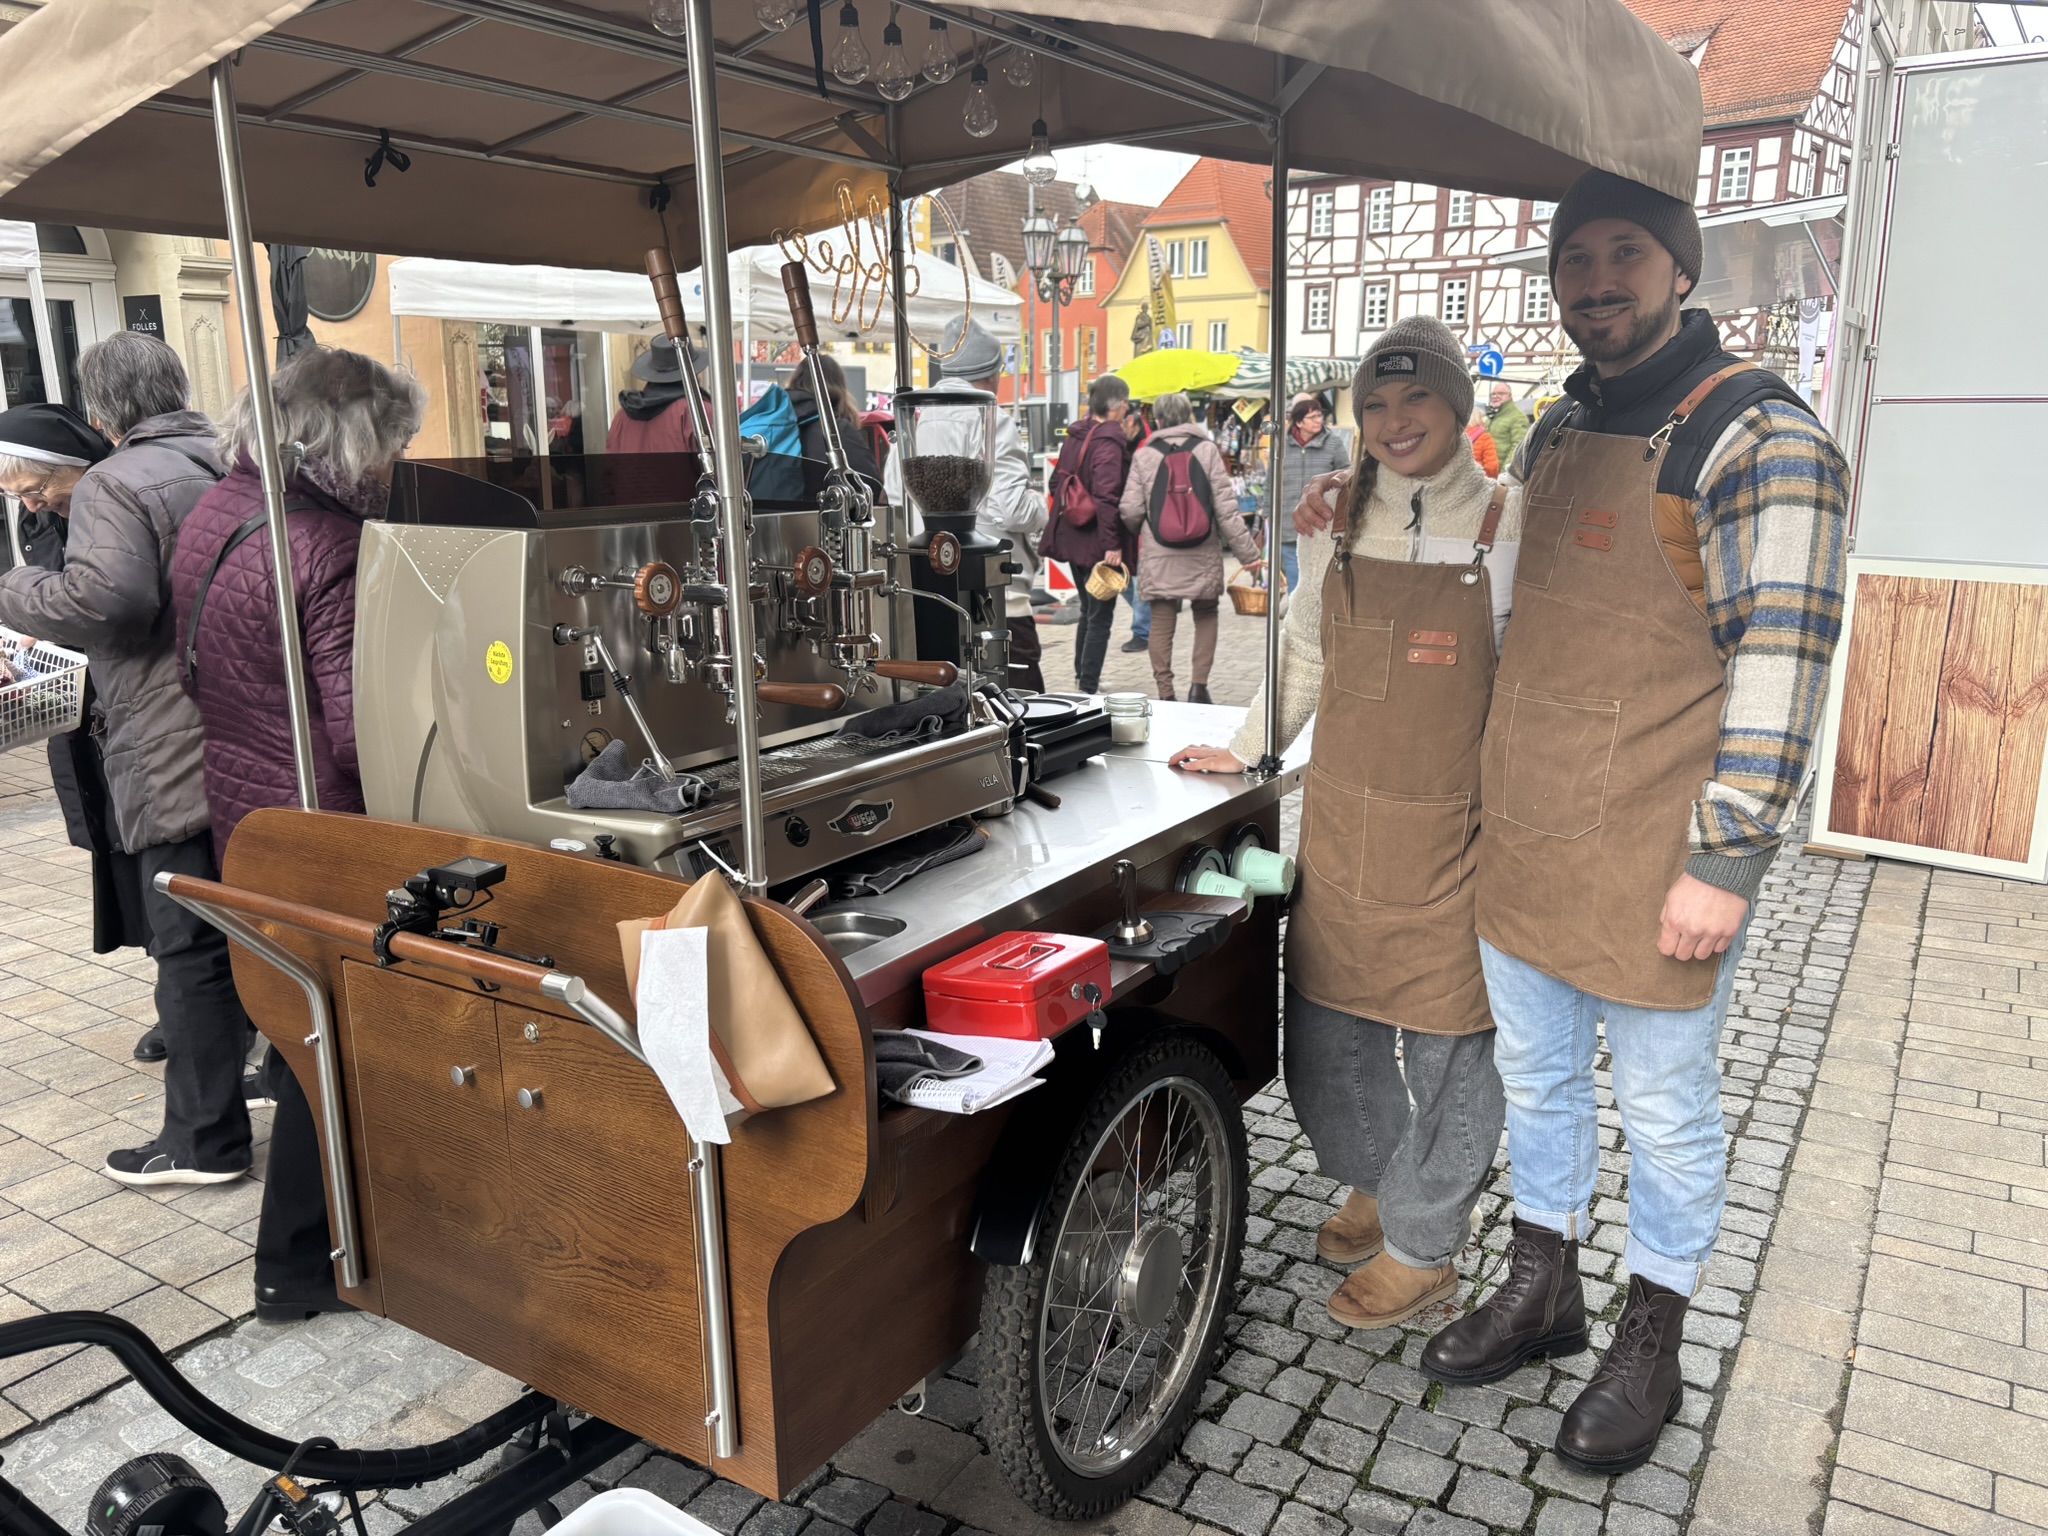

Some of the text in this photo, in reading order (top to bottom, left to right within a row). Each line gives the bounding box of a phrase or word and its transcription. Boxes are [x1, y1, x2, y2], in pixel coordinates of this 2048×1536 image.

[132, 322, 157, 331] FOLLES
[978, 774, 1000, 788] VELA
[851, 810, 877, 826] WEGA
